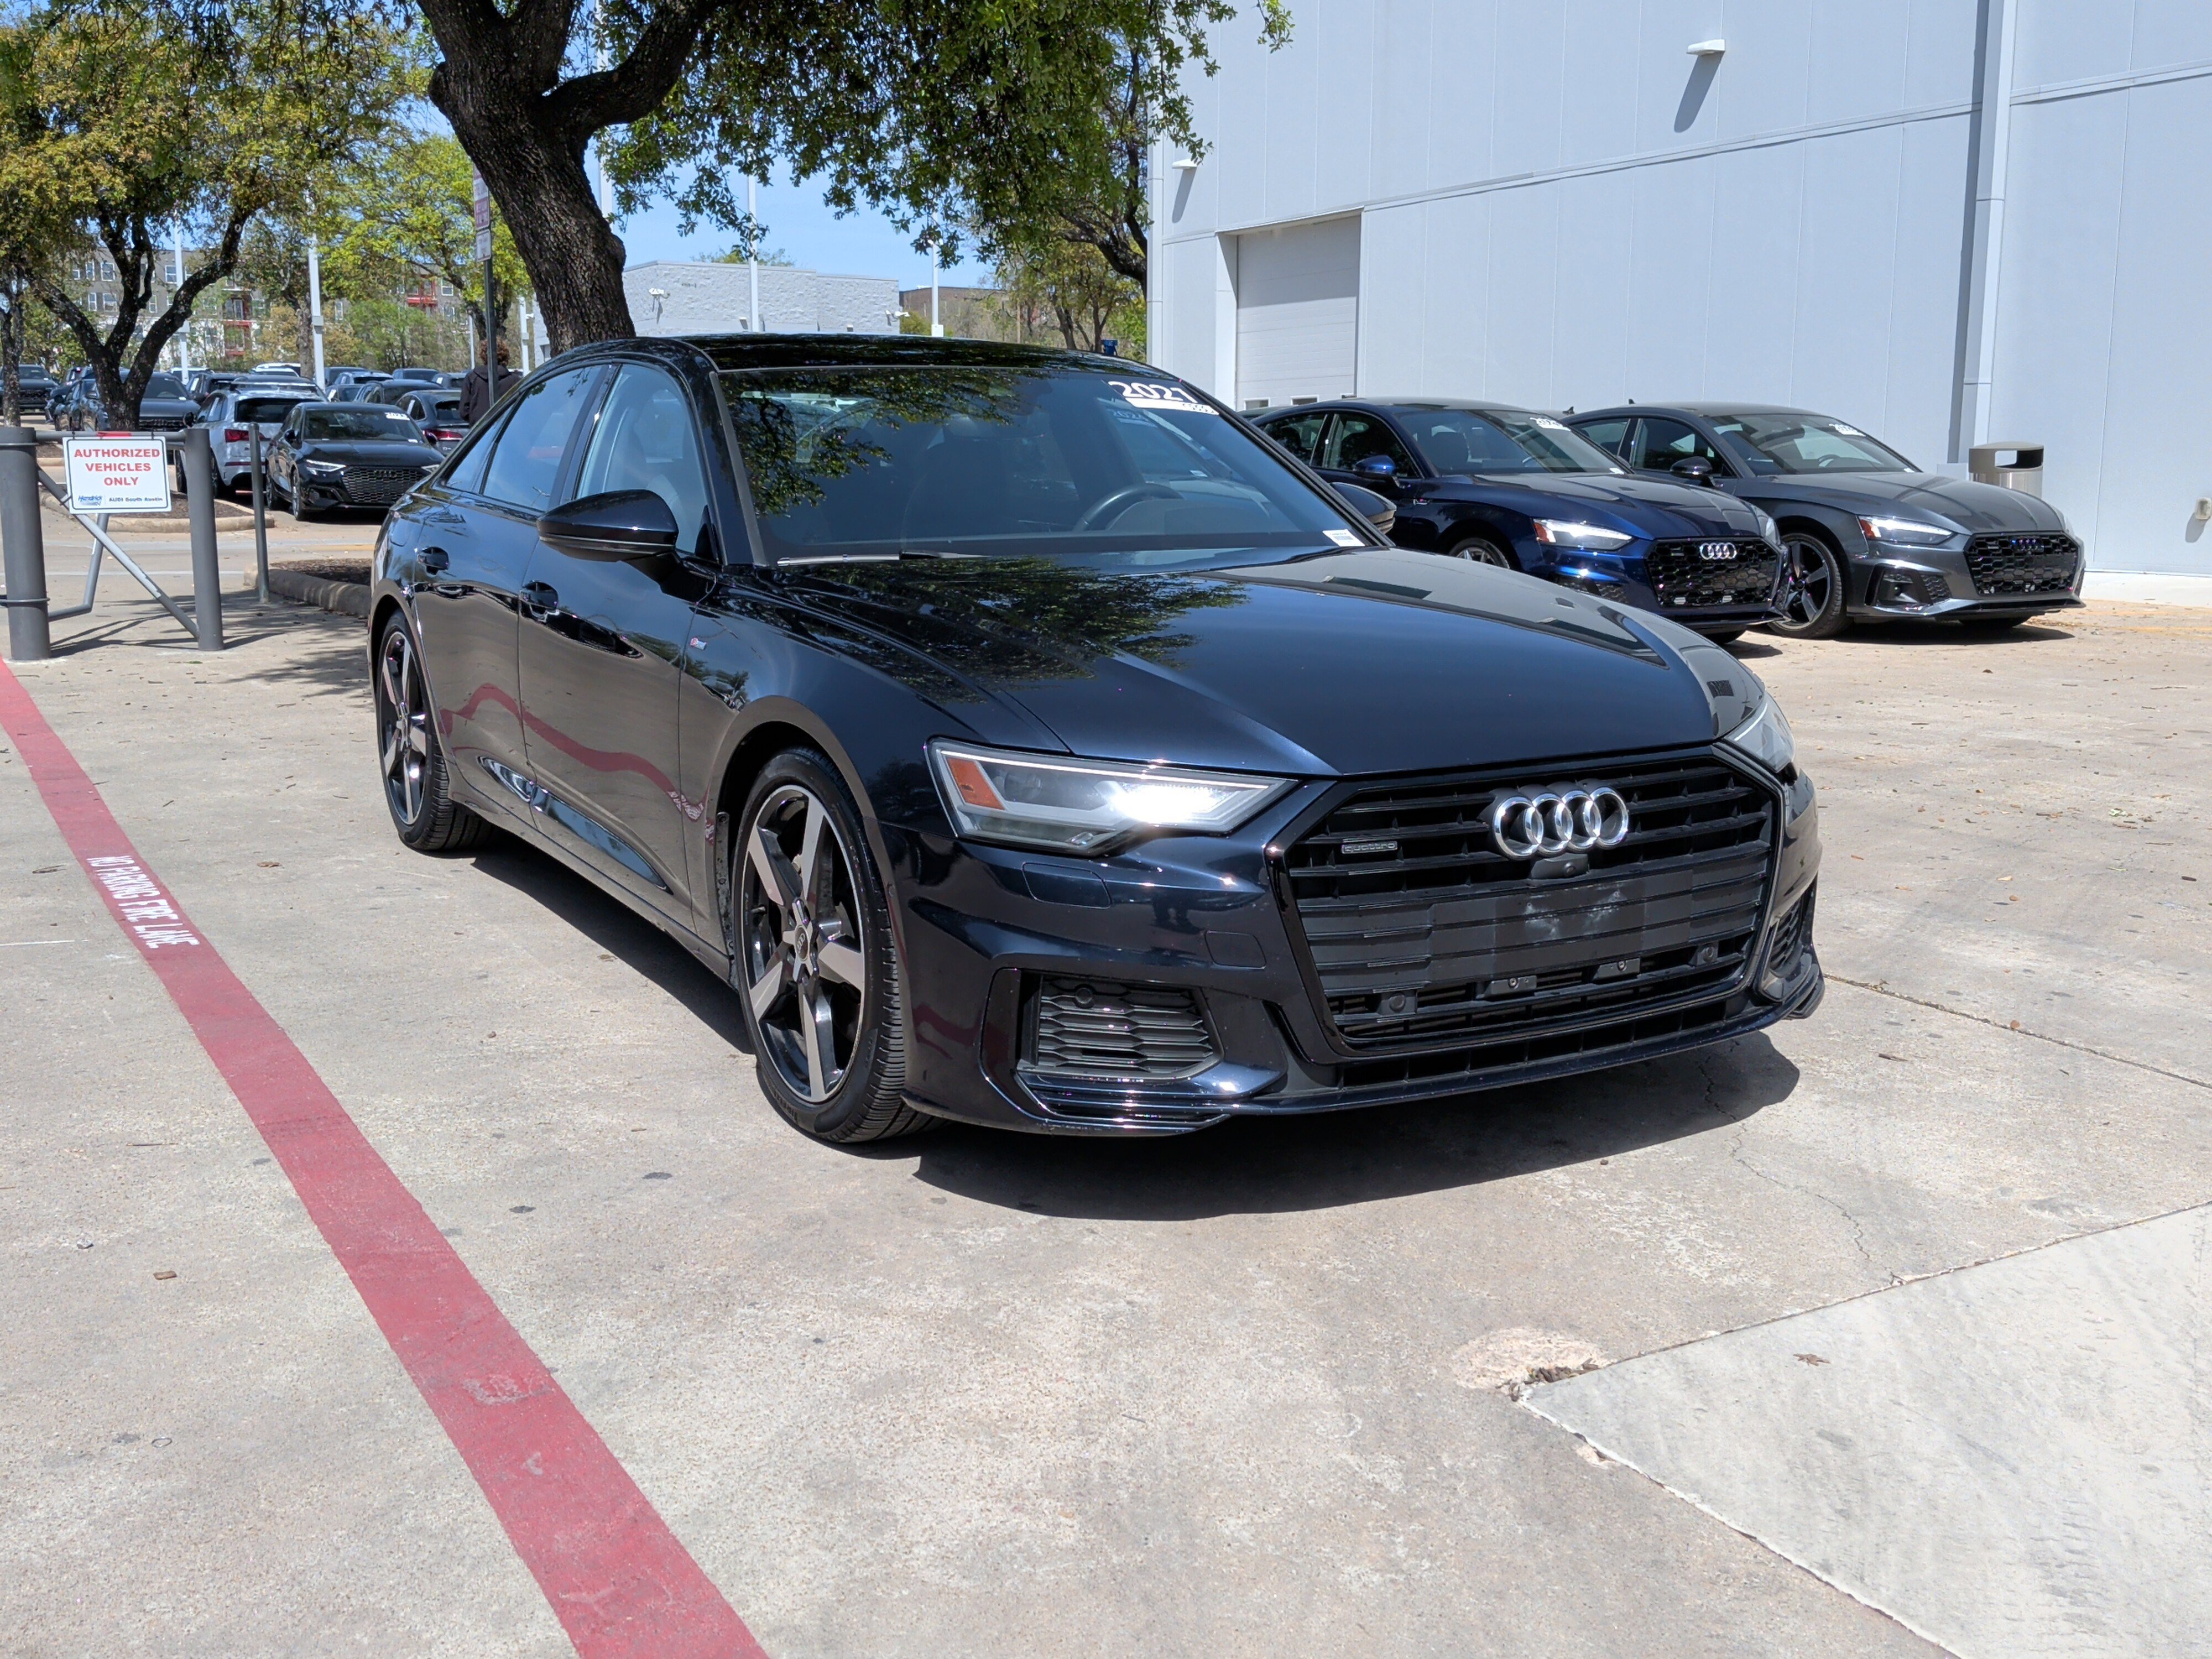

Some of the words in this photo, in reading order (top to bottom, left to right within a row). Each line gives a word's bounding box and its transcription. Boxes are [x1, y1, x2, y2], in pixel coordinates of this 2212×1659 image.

[1108, 381, 1198, 404] 2021
[74, 448, 160, 458] AUTHORIZED
[85, 463, 151, 471] VEHICLES
[103, 477, 138, 486] ONLY
[1344, 842, 1396, 852] quattro
[86, 855, 135, 867] NO
[95, 866, 160, 899] PARKING
[118, 899, 179, 922] FIRE
[133, 923, 200, 948] LANE
